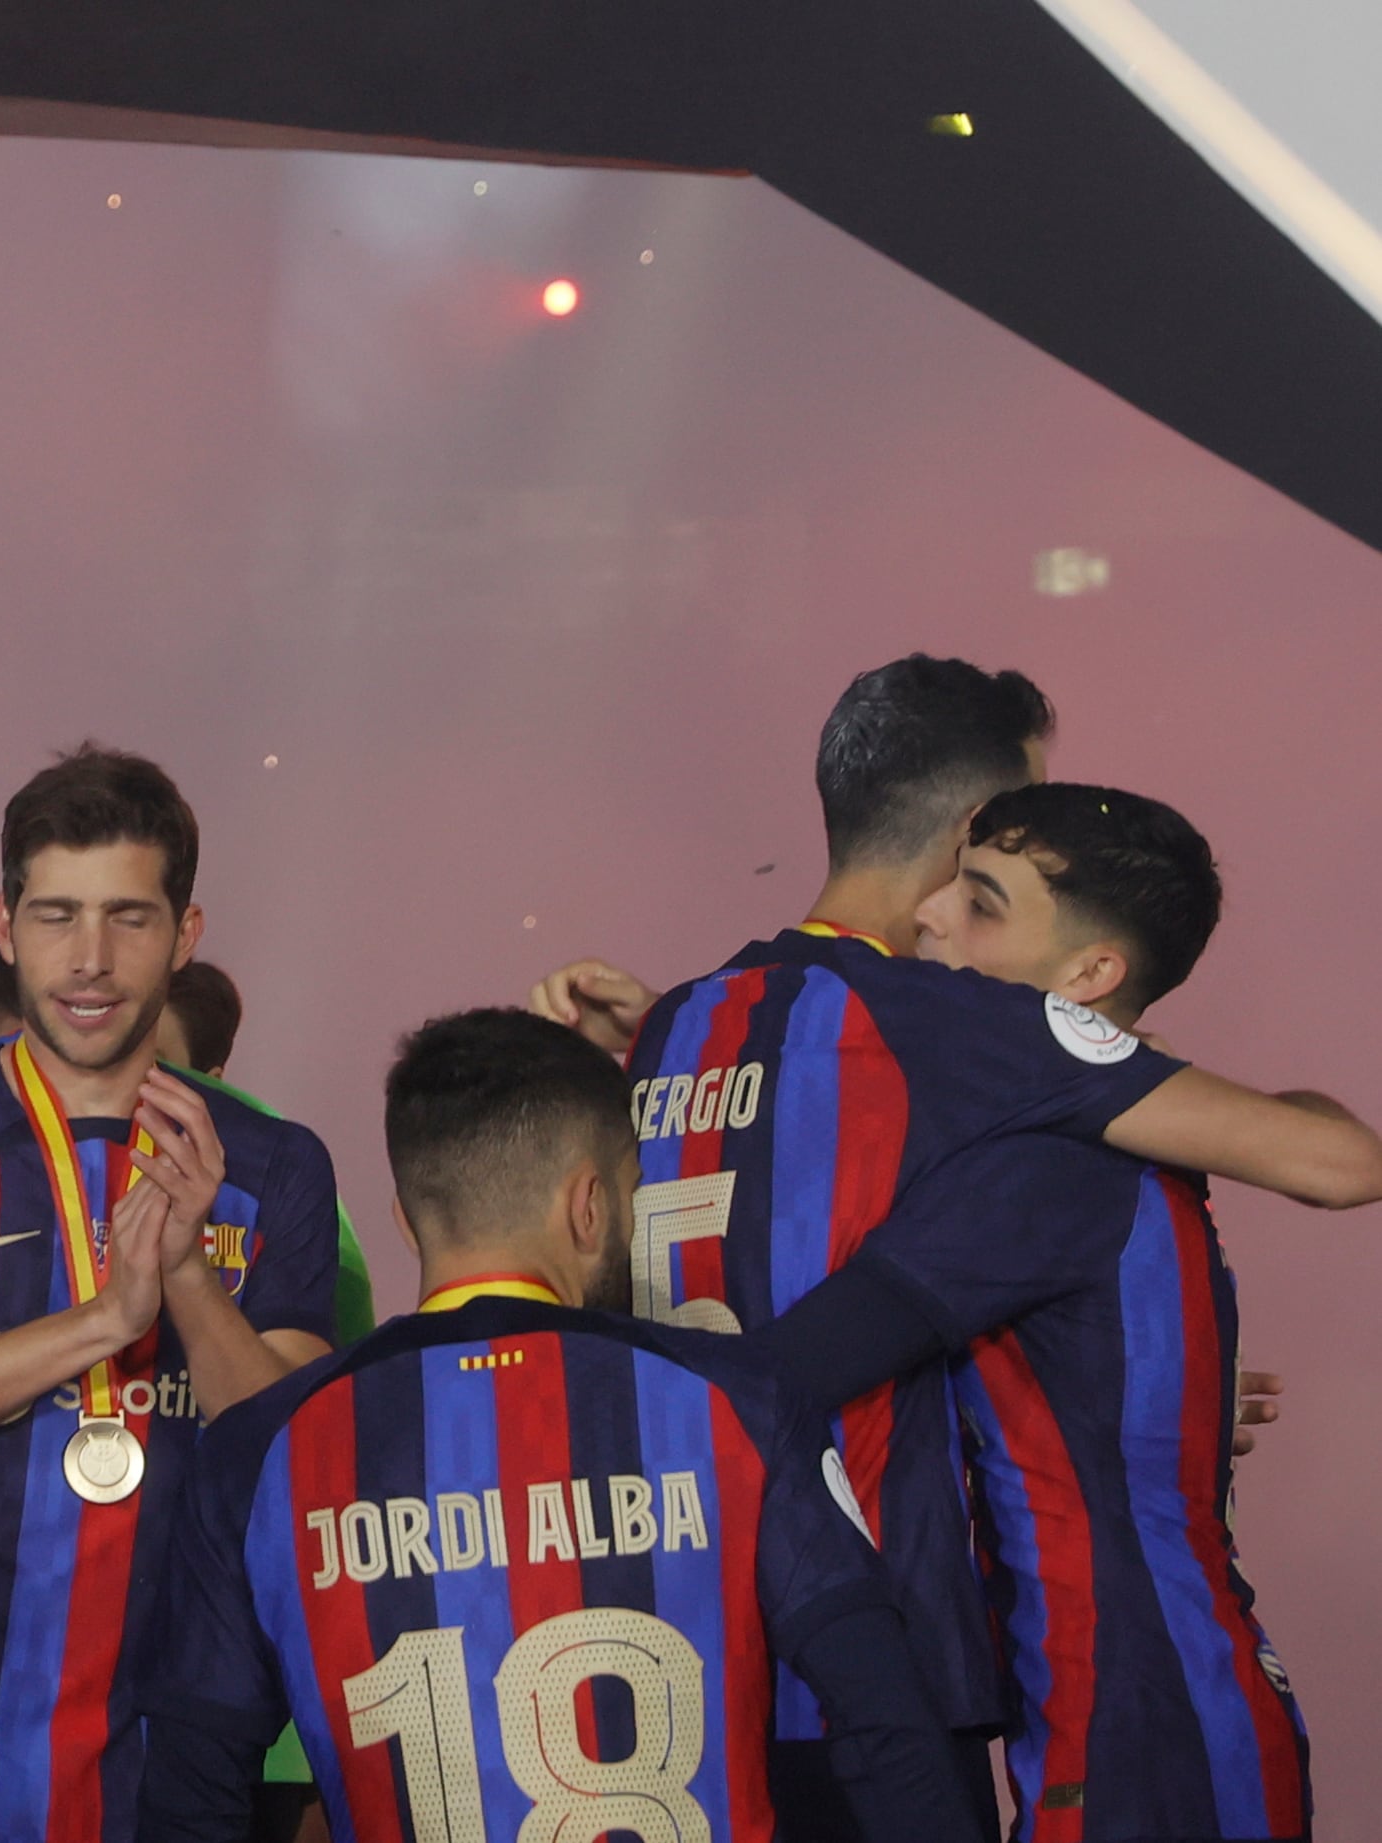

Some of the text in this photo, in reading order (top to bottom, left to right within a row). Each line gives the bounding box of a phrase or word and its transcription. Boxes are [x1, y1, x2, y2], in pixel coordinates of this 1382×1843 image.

[630, 1061, 764, 1142] SERGIO
[307, 1471, 709, 1590] JORDI ALBA
[342, 1607, 712, 1843] 18
